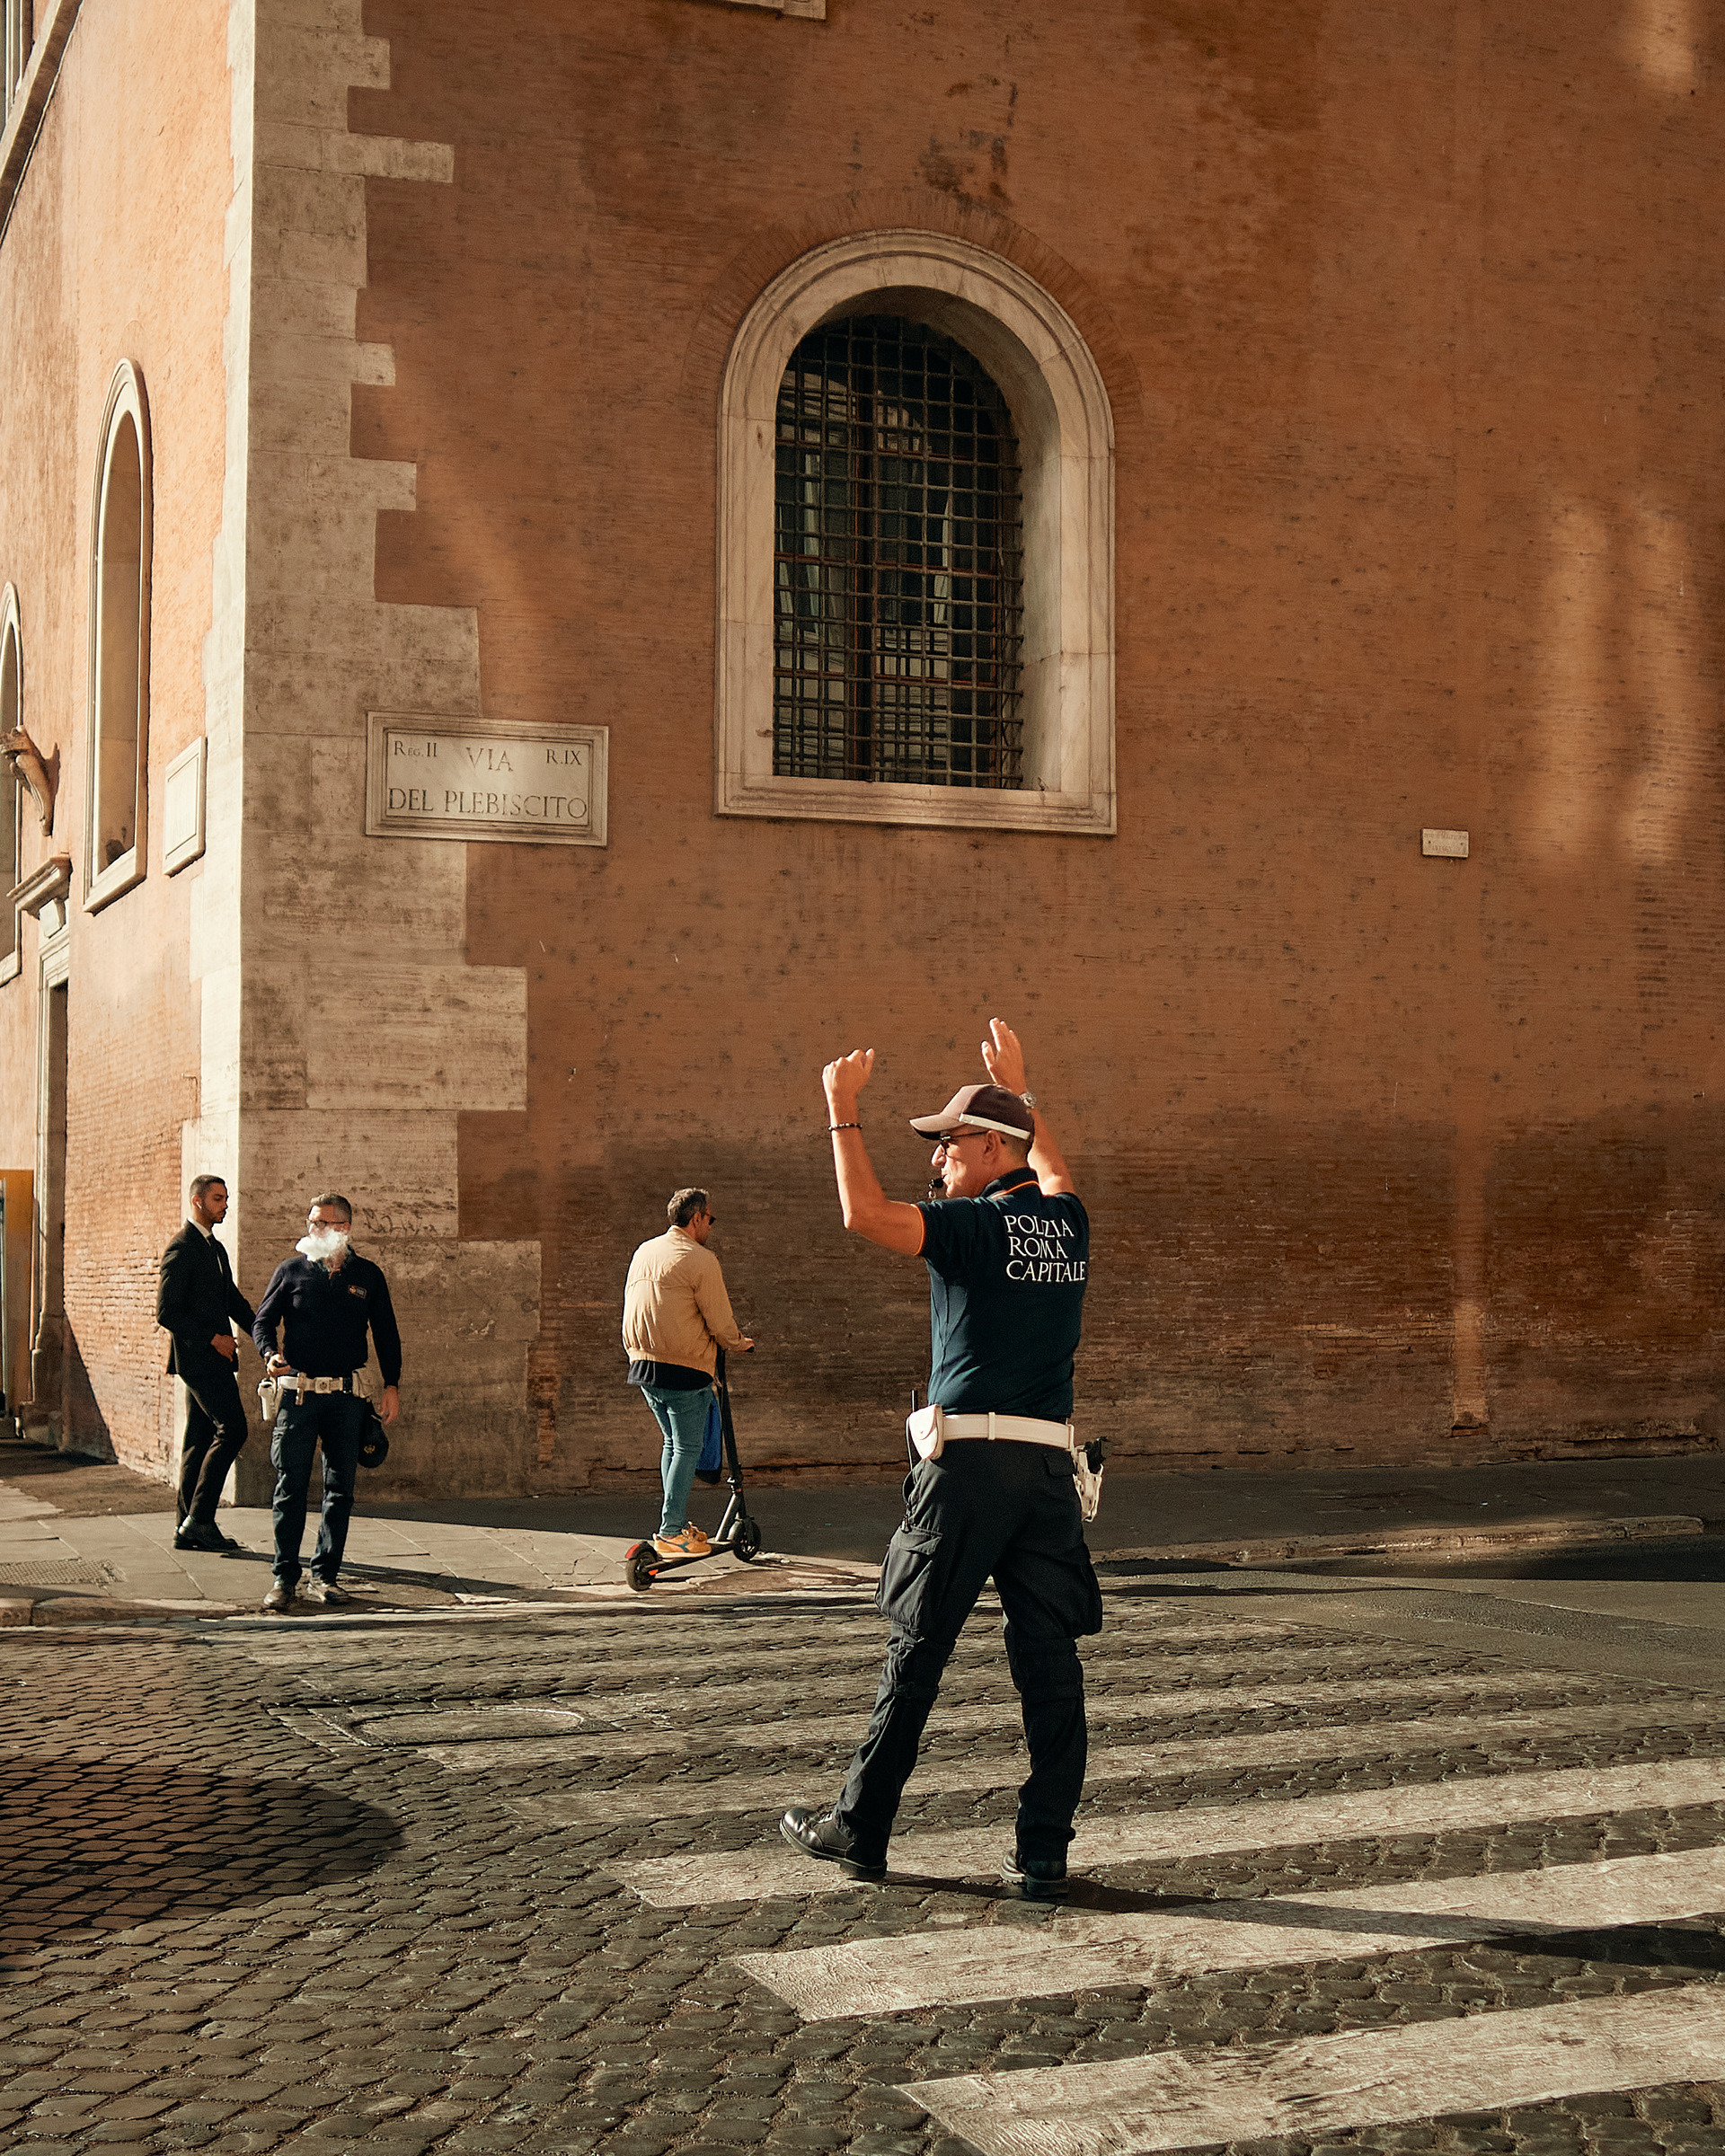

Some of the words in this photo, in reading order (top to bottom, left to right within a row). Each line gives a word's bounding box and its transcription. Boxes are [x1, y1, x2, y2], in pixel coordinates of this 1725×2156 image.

[466, 747, 514, 773] VIA
[388, 787, 434, 812] DEL
[444, 791, 588, 818] PLEBISCITO
[1008, 1235, 1068, 1259] ROMA
[1006, 1259, 1086, 1283] CAPITALE
